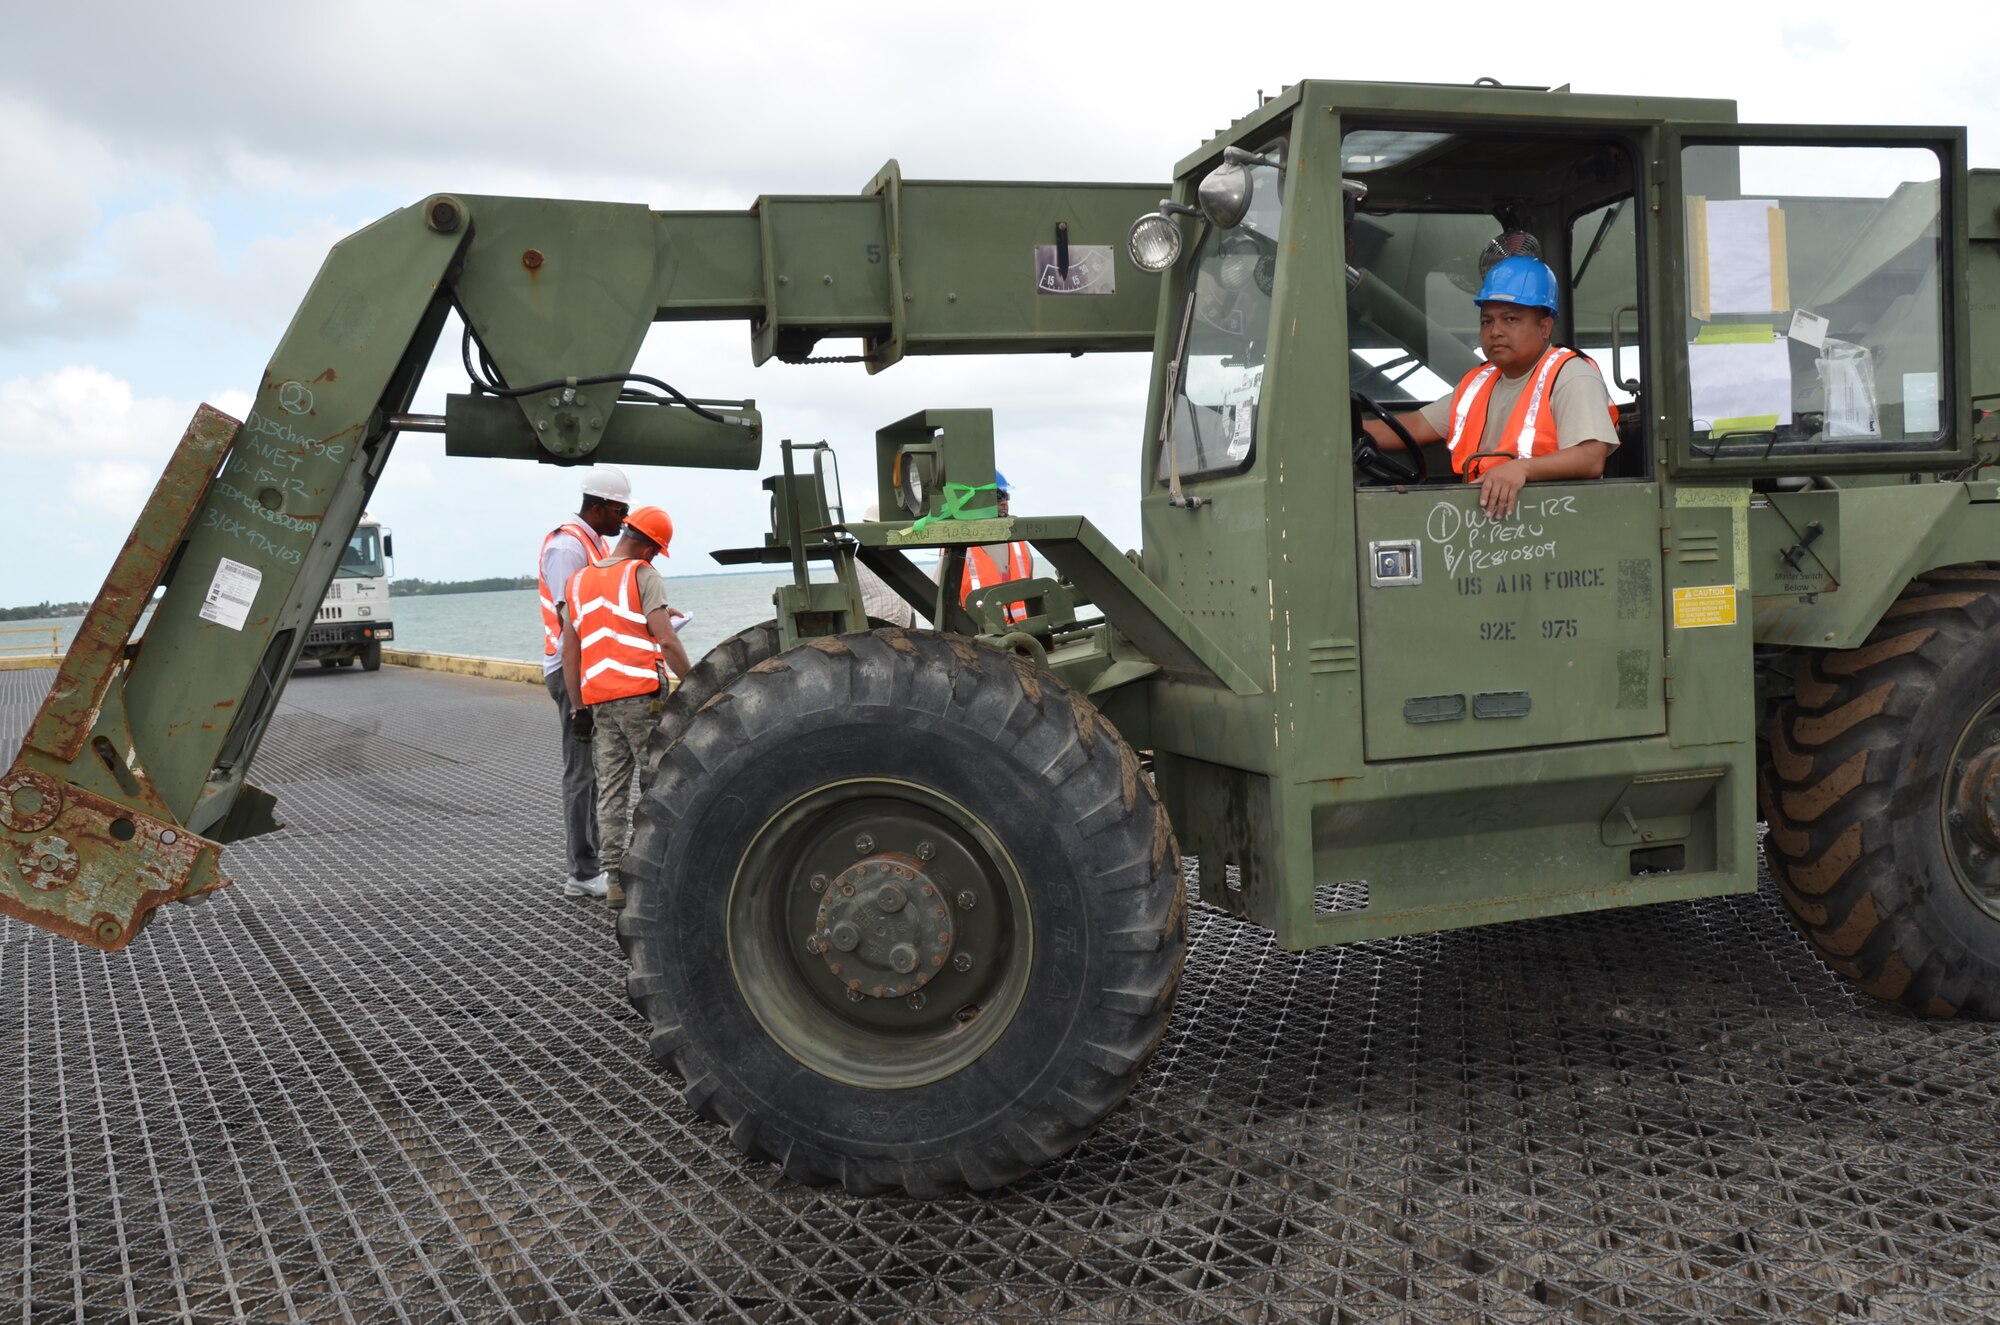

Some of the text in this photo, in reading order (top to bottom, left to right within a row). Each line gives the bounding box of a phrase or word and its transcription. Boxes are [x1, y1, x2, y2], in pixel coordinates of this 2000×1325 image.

[866, 245, 882, 265] 5
[1457, 568, 1605, 596] US AIR FORCE
[1775, 572, 1823, 580] Master Switch
[1693, 588, 1725, 597] CAUTION
[1784, 583, 1809, 592] Below
[1480, 619, 1577, 641] 92E 975
